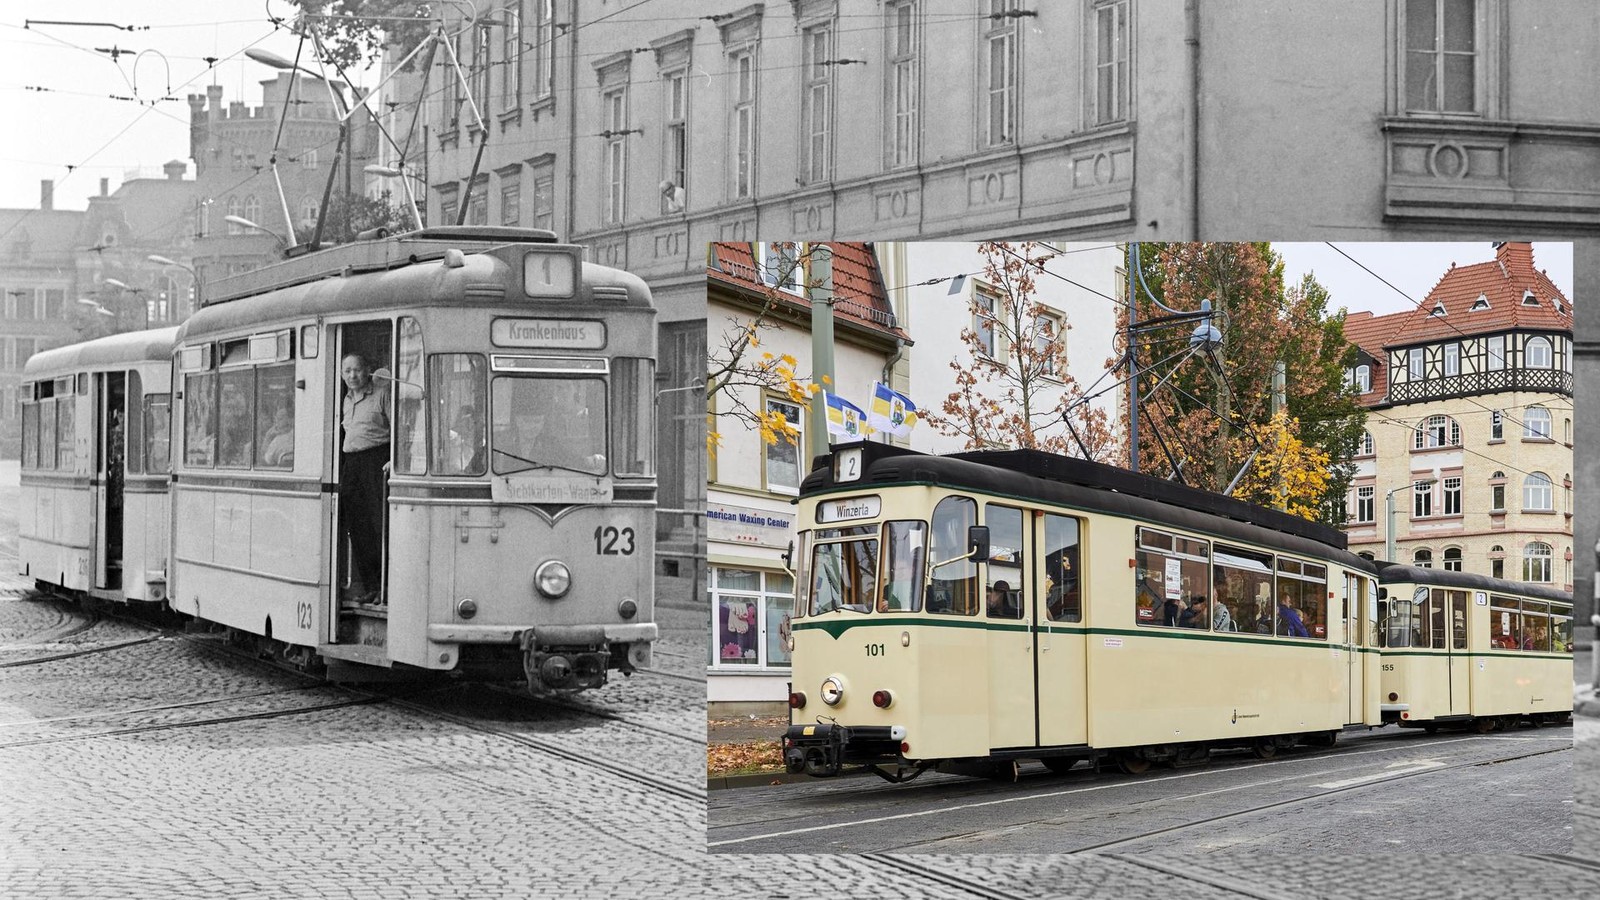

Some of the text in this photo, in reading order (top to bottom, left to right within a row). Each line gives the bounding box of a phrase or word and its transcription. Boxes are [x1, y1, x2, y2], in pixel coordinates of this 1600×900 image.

[542, 256, 552, 286] 1
[509, 321, 586, 340] Krankenhaus
[848, 457, 856, 476] 2
[836, 503, 869, 518] Winzerla
[739, 513, 765, 526] Waxing
[767, 517, 790, 528] Center
[594, 525, 635, 556] 123
[297, 601, 312, 630] 123
[865, 644, 884, 656] 101
